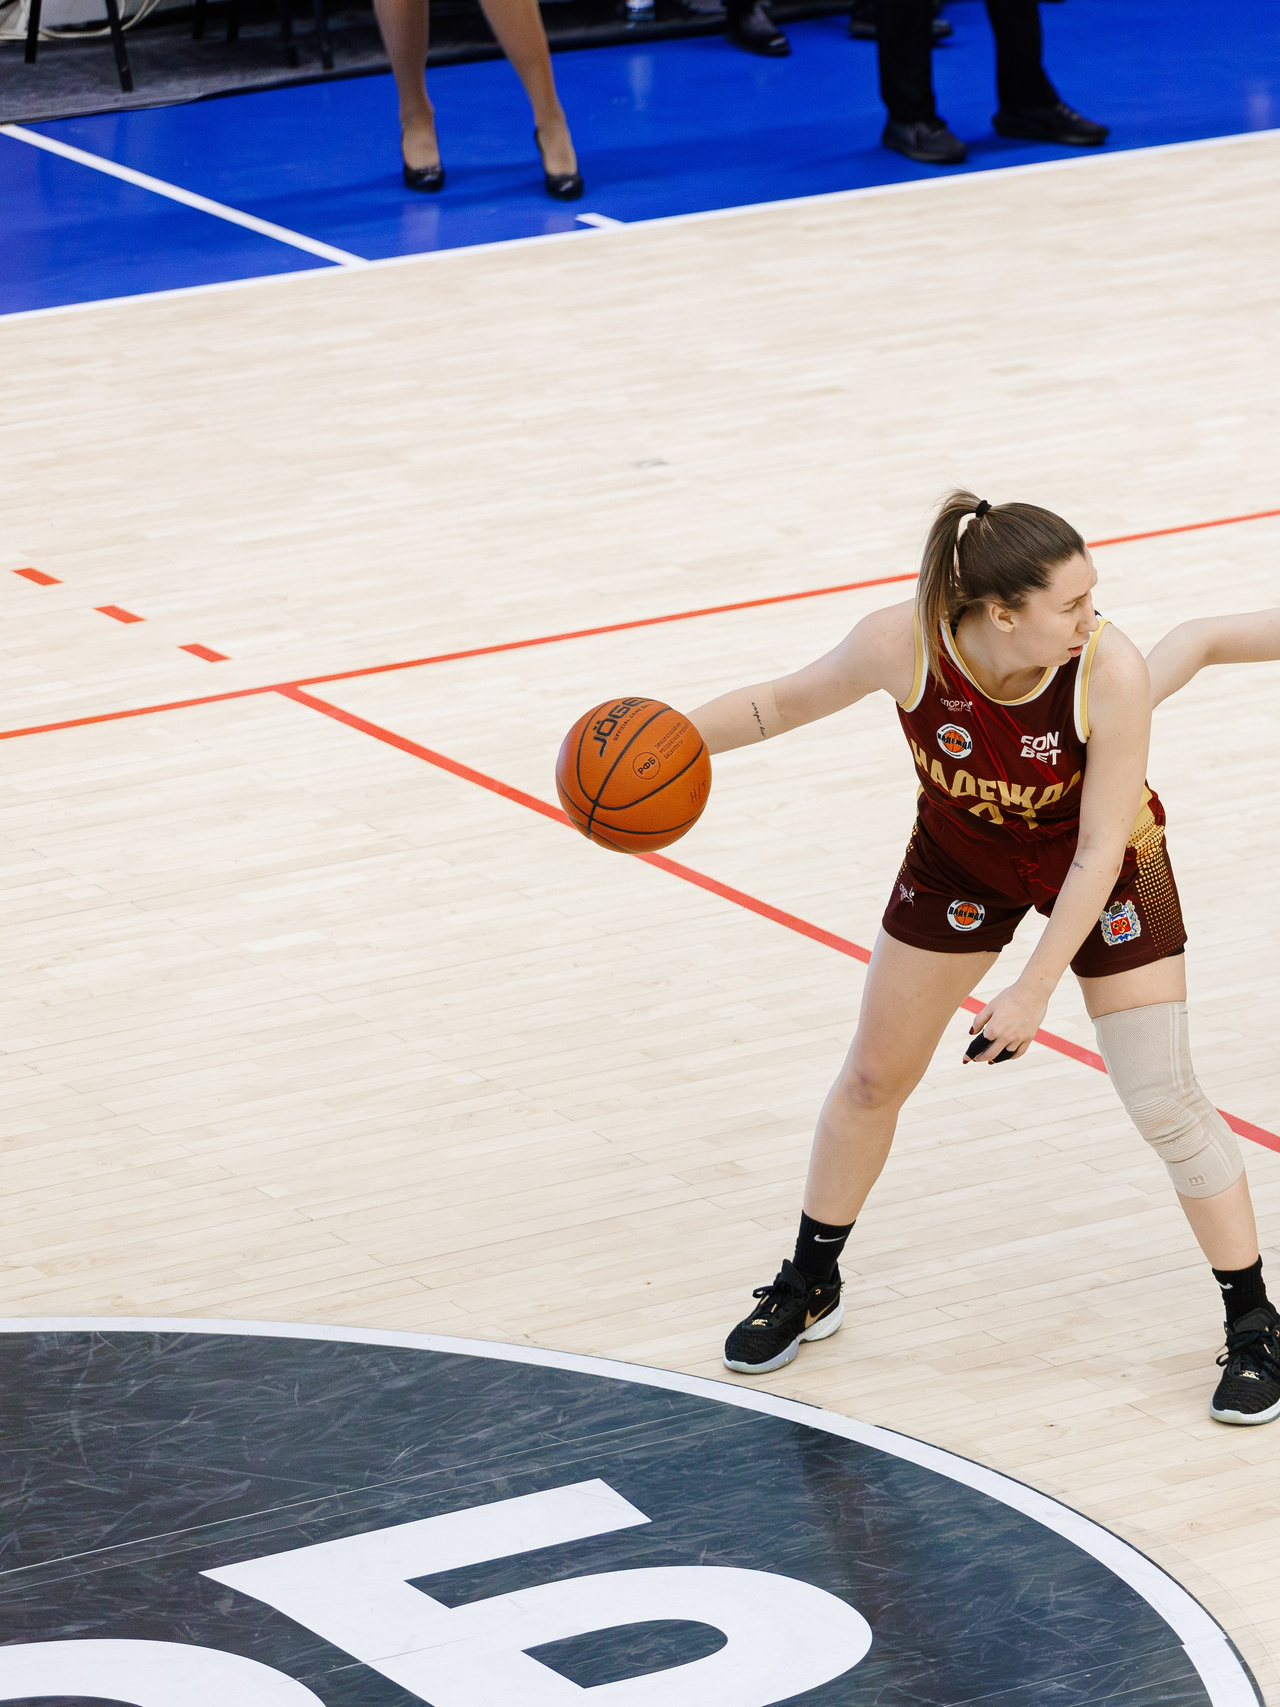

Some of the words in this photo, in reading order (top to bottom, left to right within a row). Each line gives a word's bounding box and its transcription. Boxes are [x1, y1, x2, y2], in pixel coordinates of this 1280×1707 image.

[1020, 731, 1060, 750] FON
[1020, 745, 1062, 765] BET
[637, 756, 656, 775] РФБ
